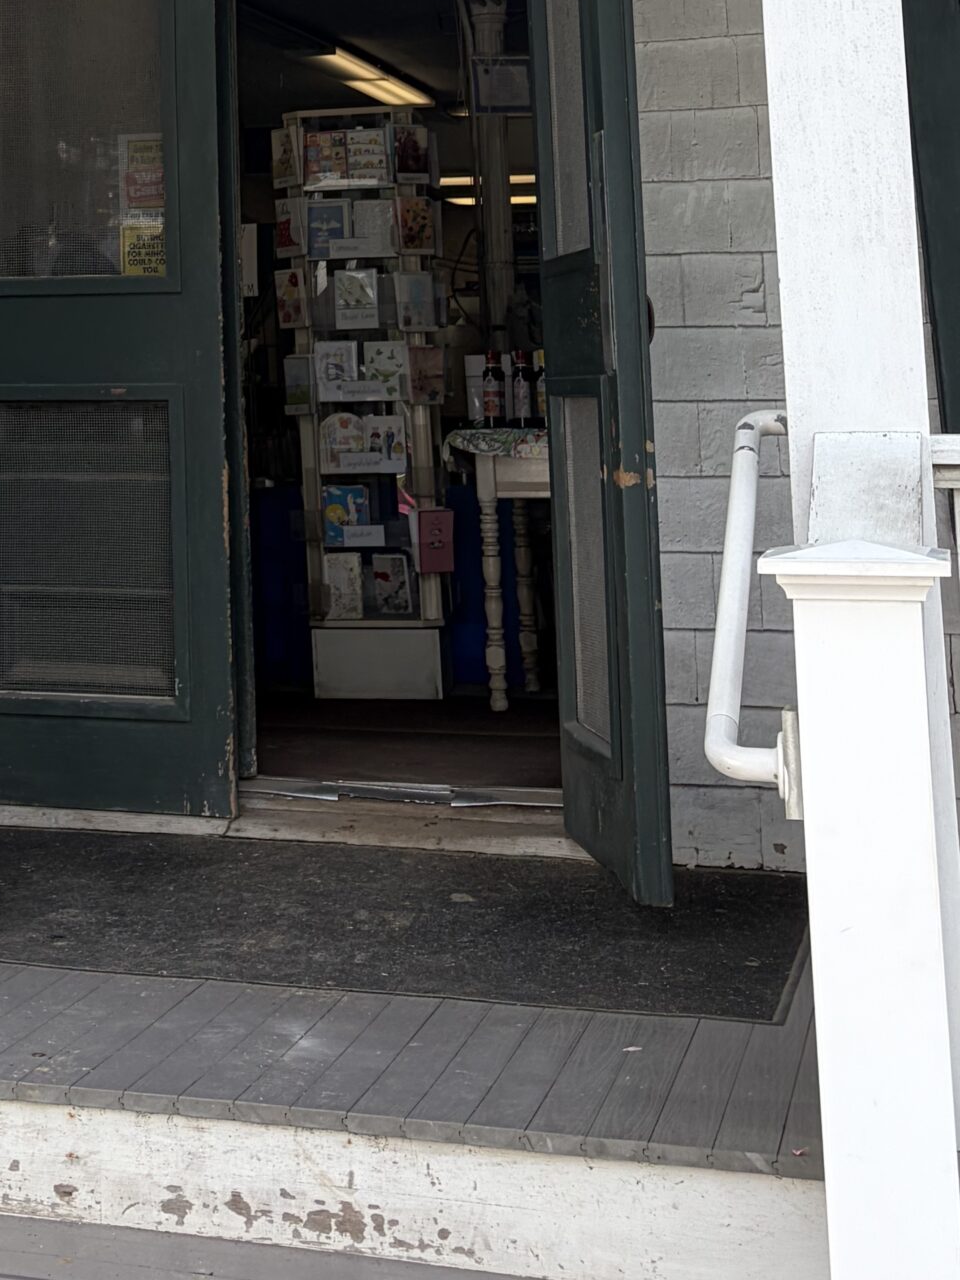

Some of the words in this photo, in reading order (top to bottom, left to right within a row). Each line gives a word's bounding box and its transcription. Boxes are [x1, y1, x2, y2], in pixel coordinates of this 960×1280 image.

[127, 250, 142, 258] FOR
[144, 250, 165, 258] MINO
[127, 258, 153, 266] COULD
[155, 258, 166, 266] CO
[142, 266, 159, 274] YOU
